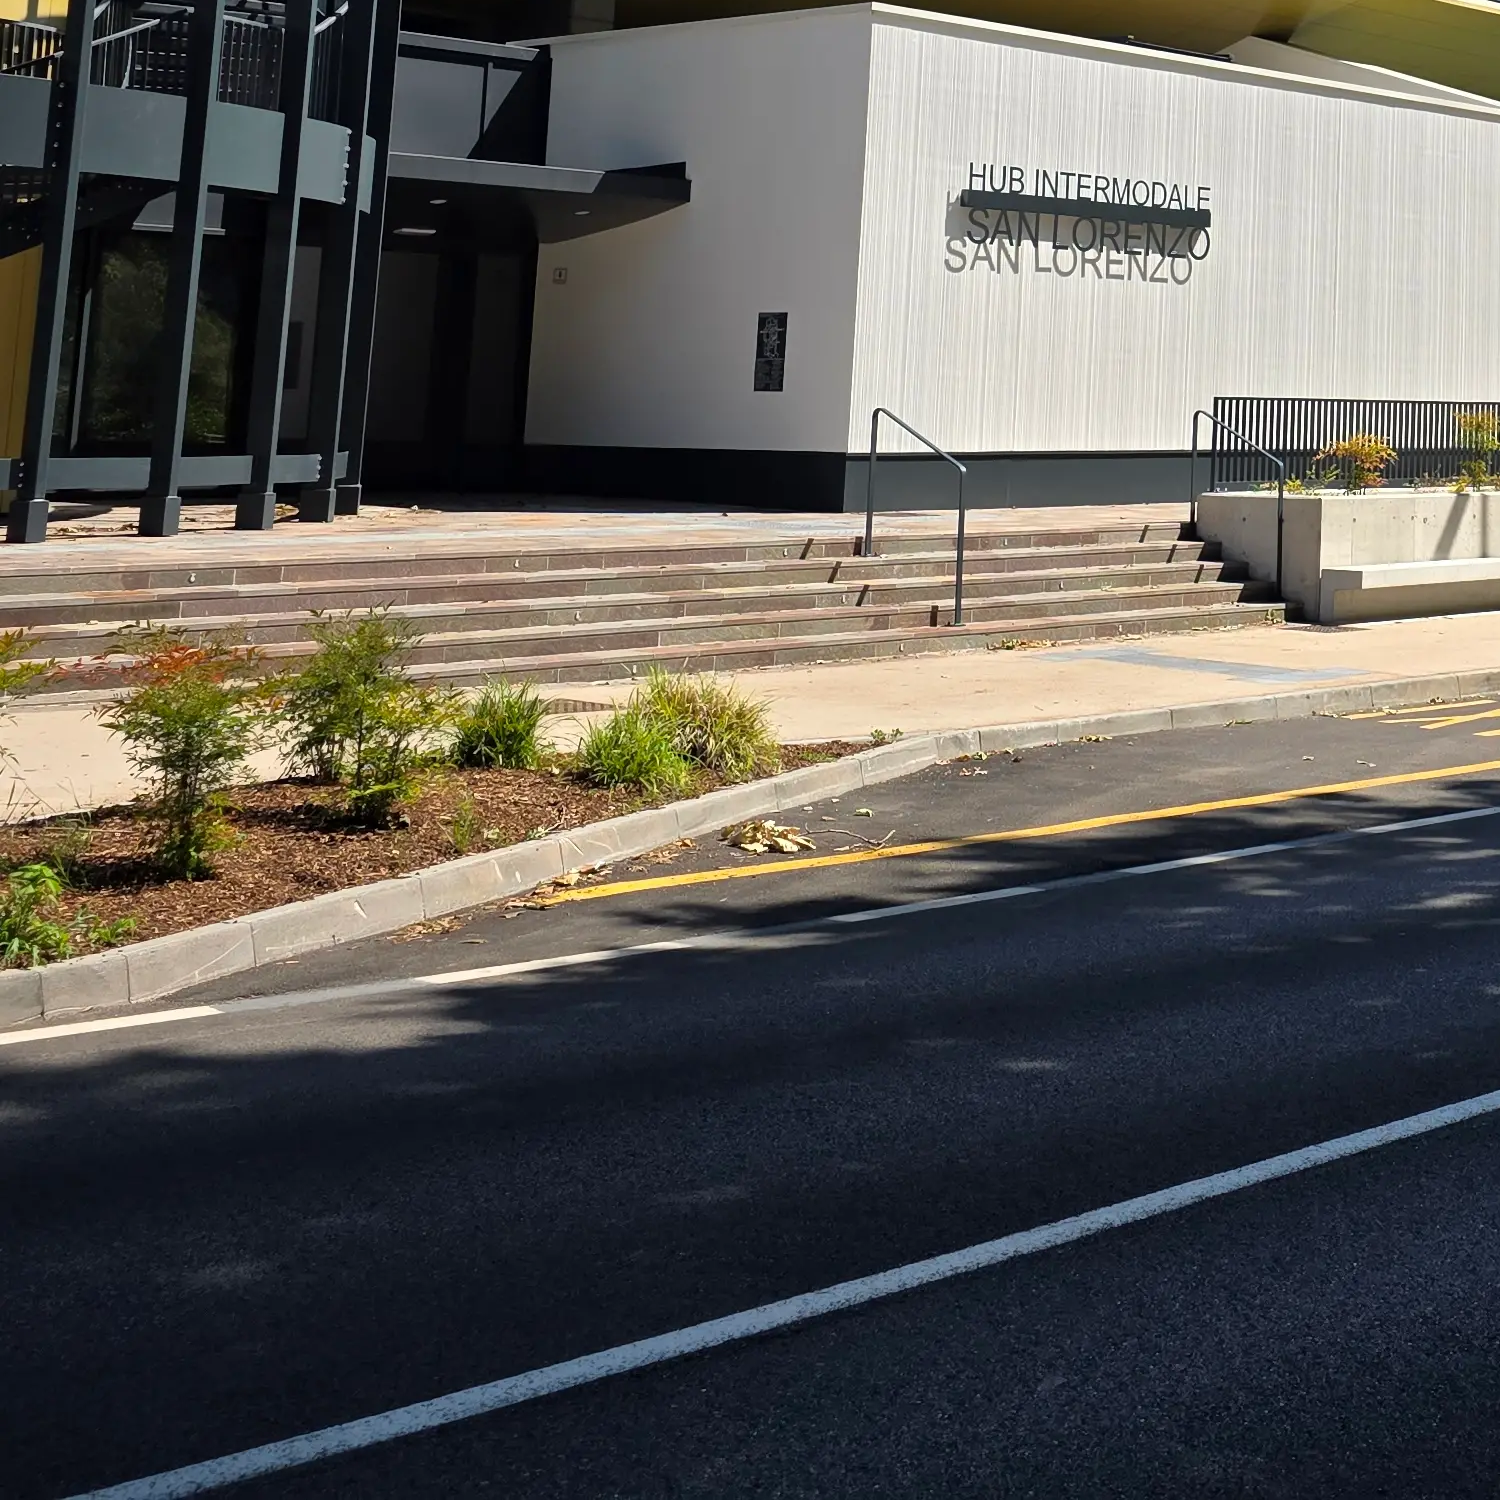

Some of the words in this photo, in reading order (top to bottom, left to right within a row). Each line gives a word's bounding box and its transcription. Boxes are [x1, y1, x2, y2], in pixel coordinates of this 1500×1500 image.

[969, 162, 1025, 194] HUB
[1035, 169, 1211, 211] INTERMODALE
[967, 208, 1040, 247] SAN
[1052, 213, 1211, 260] LORENZO
